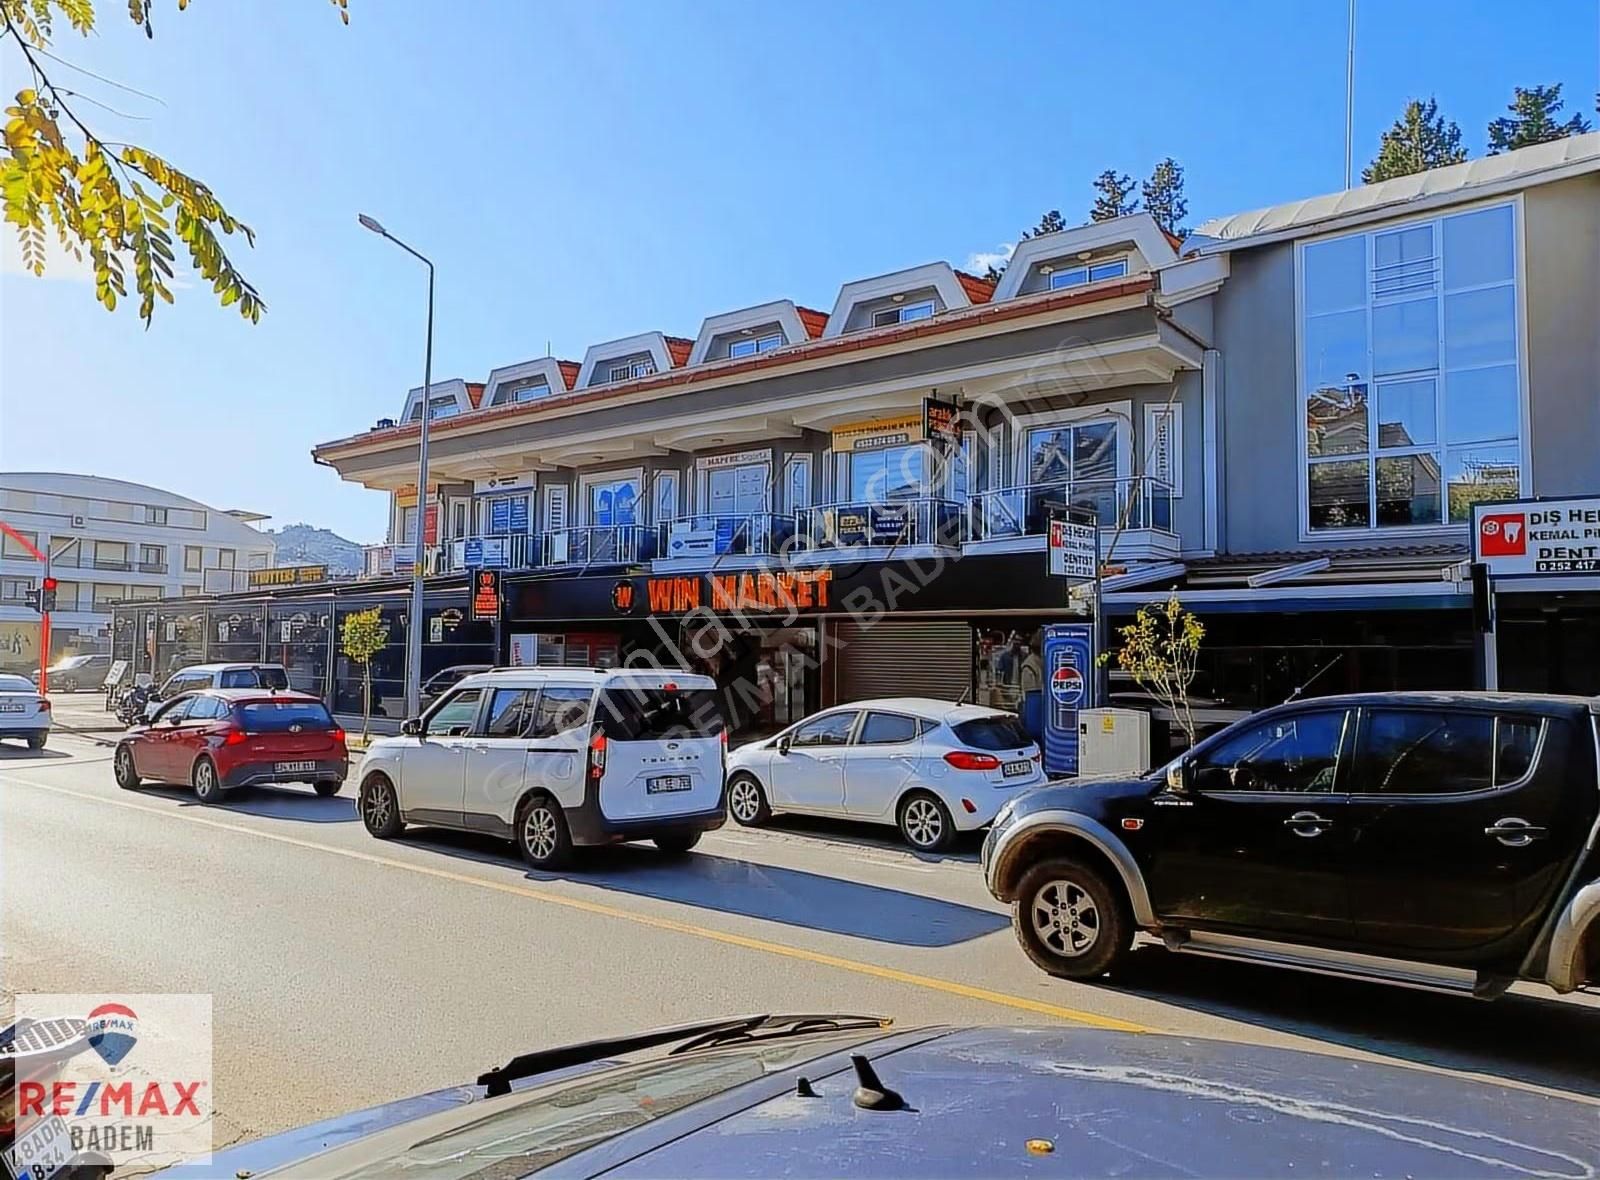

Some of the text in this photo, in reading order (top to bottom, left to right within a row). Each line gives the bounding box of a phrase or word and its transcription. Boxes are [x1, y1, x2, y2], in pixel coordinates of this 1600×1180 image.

[1568, 509, 1600, 523] HE
[1529, 530, 1579, 541] KEMAL
[1575, 560, 1596, 570] 417
[648, 569, 833, 612] WIN MARKET
[1053, 680, 1082, 690] PEPSI
